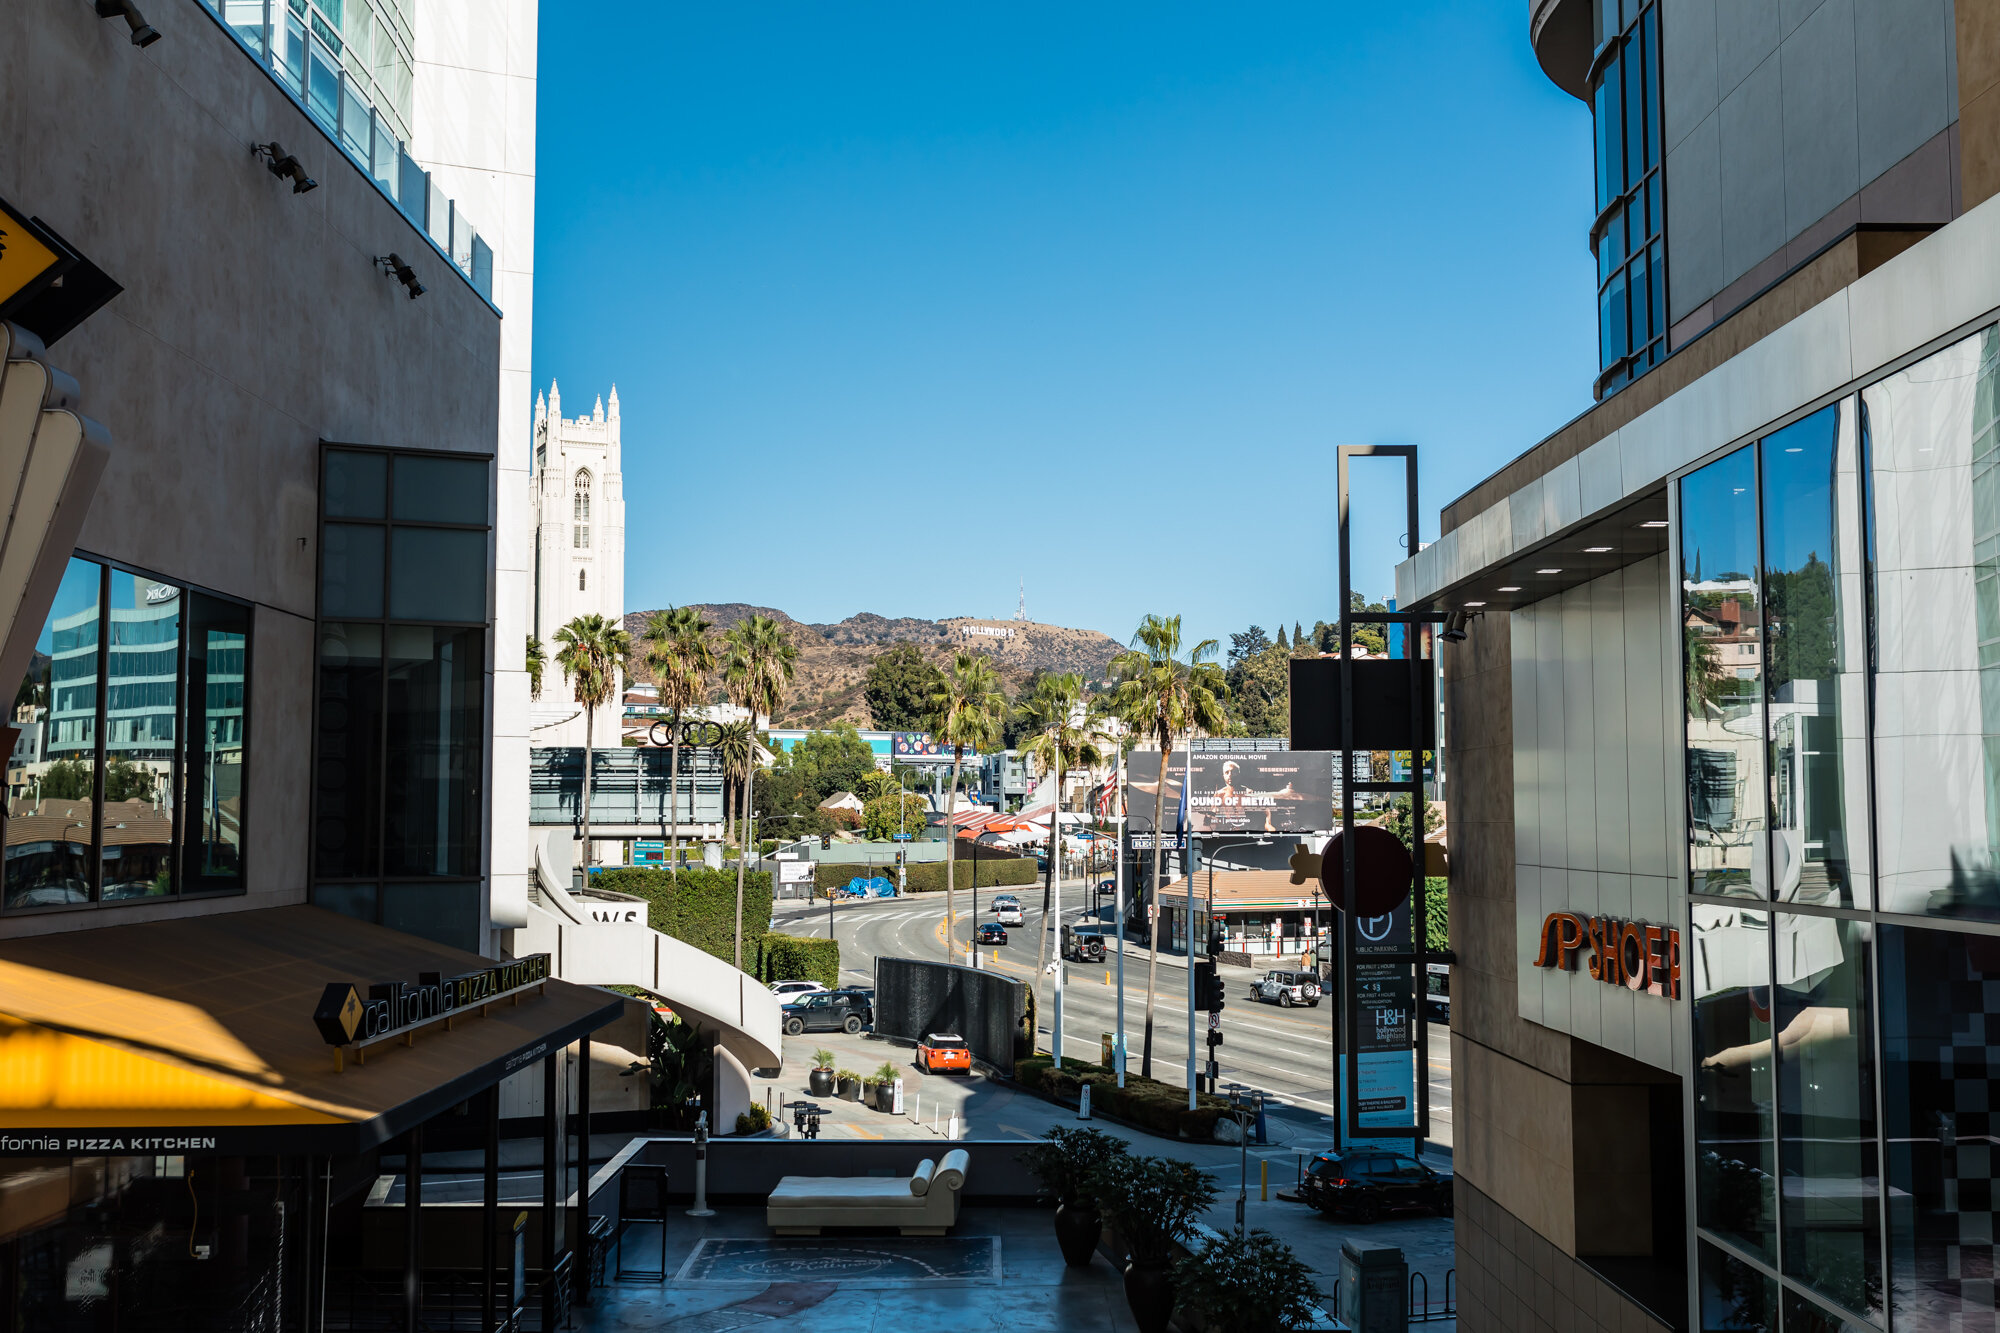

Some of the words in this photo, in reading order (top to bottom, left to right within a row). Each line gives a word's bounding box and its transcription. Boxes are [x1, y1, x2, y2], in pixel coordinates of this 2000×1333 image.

[962, 625, 1014, 637] HOLLYWOOD
[1191, 797, 1222, 806] OUND
[1224, 797, 1239, 806] OF
[1241, 797, 1277, 806] METAL
[459, 968, 498, 1007] PIZZA
[502, 954, 551, 992] KITCHEN
[1376, 1008, 1406, 1025] H&H
[1376, 1025, 1406, 1034] hollywood
[67, 1139, 125, 1150] PIZZA
[131, 1137, 216, 1149] KITCHEN
